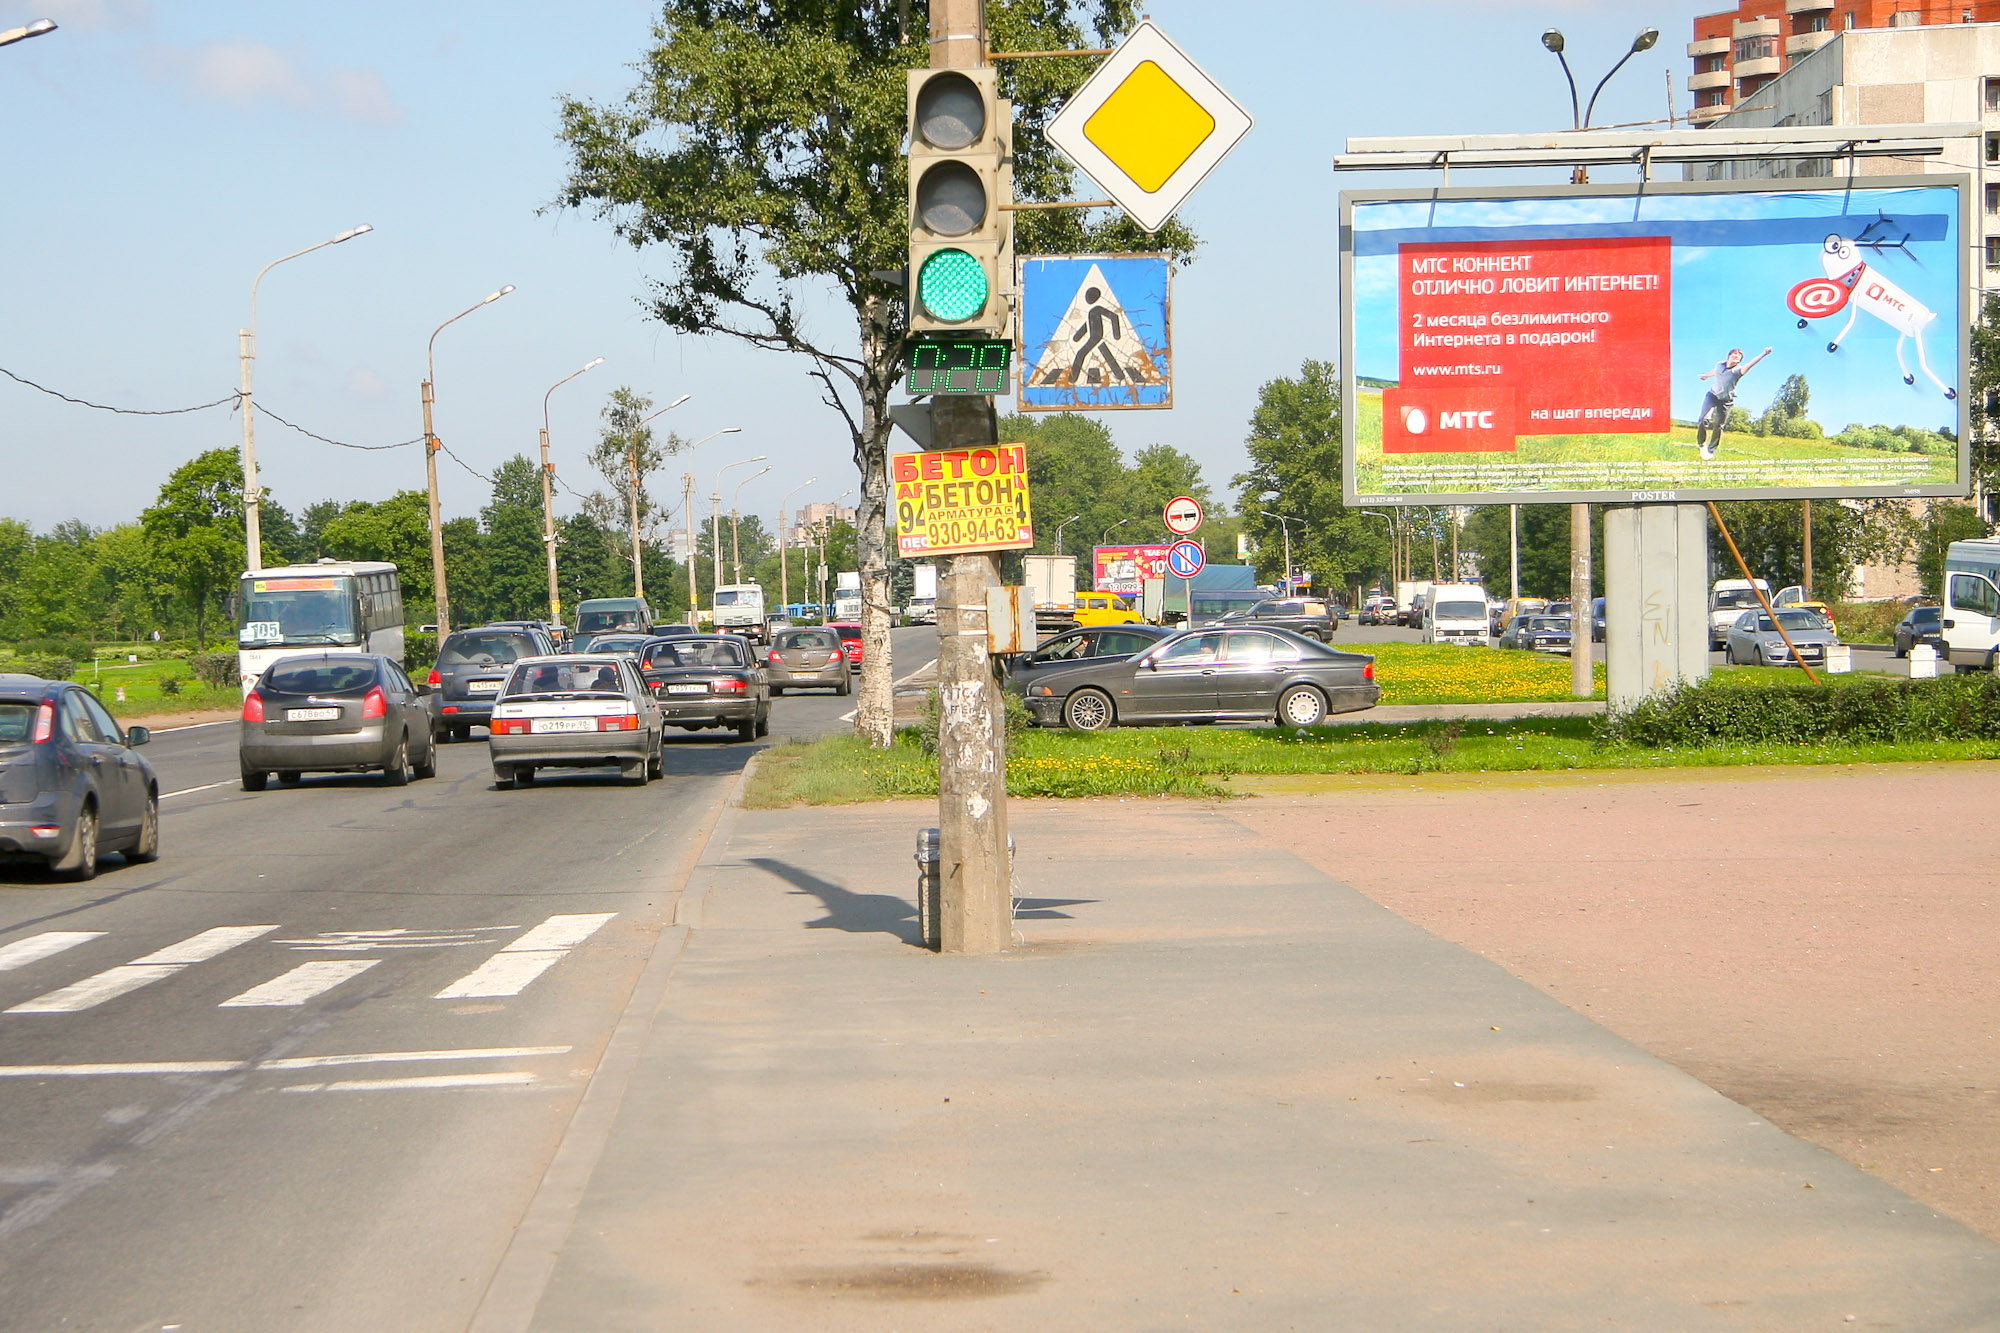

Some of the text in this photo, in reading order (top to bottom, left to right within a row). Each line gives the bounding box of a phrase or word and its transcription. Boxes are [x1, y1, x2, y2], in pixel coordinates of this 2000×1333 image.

[1412, 255, 1532, 274] МТС КОННЕКТ
[1412, 274, 1658, 296] ОТЛИЧНО ЛОВИТ ИНТЕРНЕТ!
[1883, 294, 1905, 312] МТС
[1412, 312, 1609, 330] 2 месяца безлимитного
[1413, 329, 1595, 349] Интернета в подарок!
[1413, 364, 1501, 376] www.mts.ru
[1439, 410, 1493, 430] МТС
[1530, 407, 1651, 421] на шаг впереди
[894, 447, 1025, 483] БЕТОН
[926, 478, 1013, 509] БЕТОН
[1632, 490, 1676, 500] POSTER
[928, 507, 1002, 521] АРМАТУРА
[929, 518, 1016, 546] 930-94-63
[251, 623, 278, 639] 105
